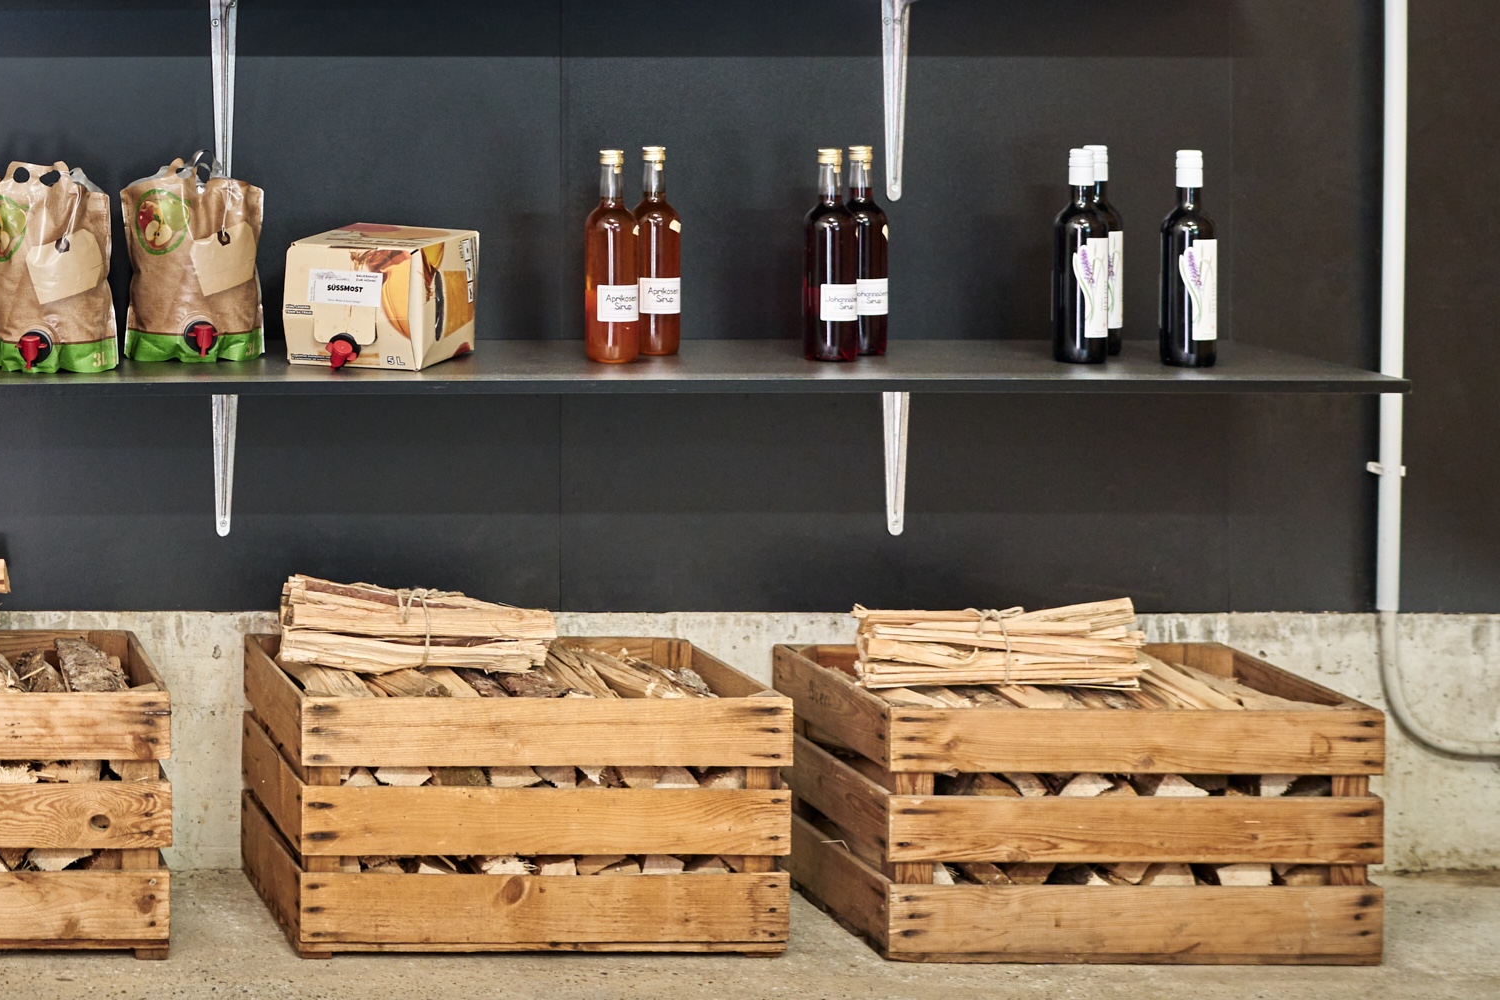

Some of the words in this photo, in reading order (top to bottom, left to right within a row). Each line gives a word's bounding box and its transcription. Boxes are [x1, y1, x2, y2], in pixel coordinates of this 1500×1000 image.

[327, 283, 364, 293] SÜSSMOST
[656, 295, 674, 303] Sirup
[614, 302, 632, 311] Sirup
[92, 351, 107, 367] 3L
[386, 355, 395, 365] 5
[396, 356, 406, 366] L
